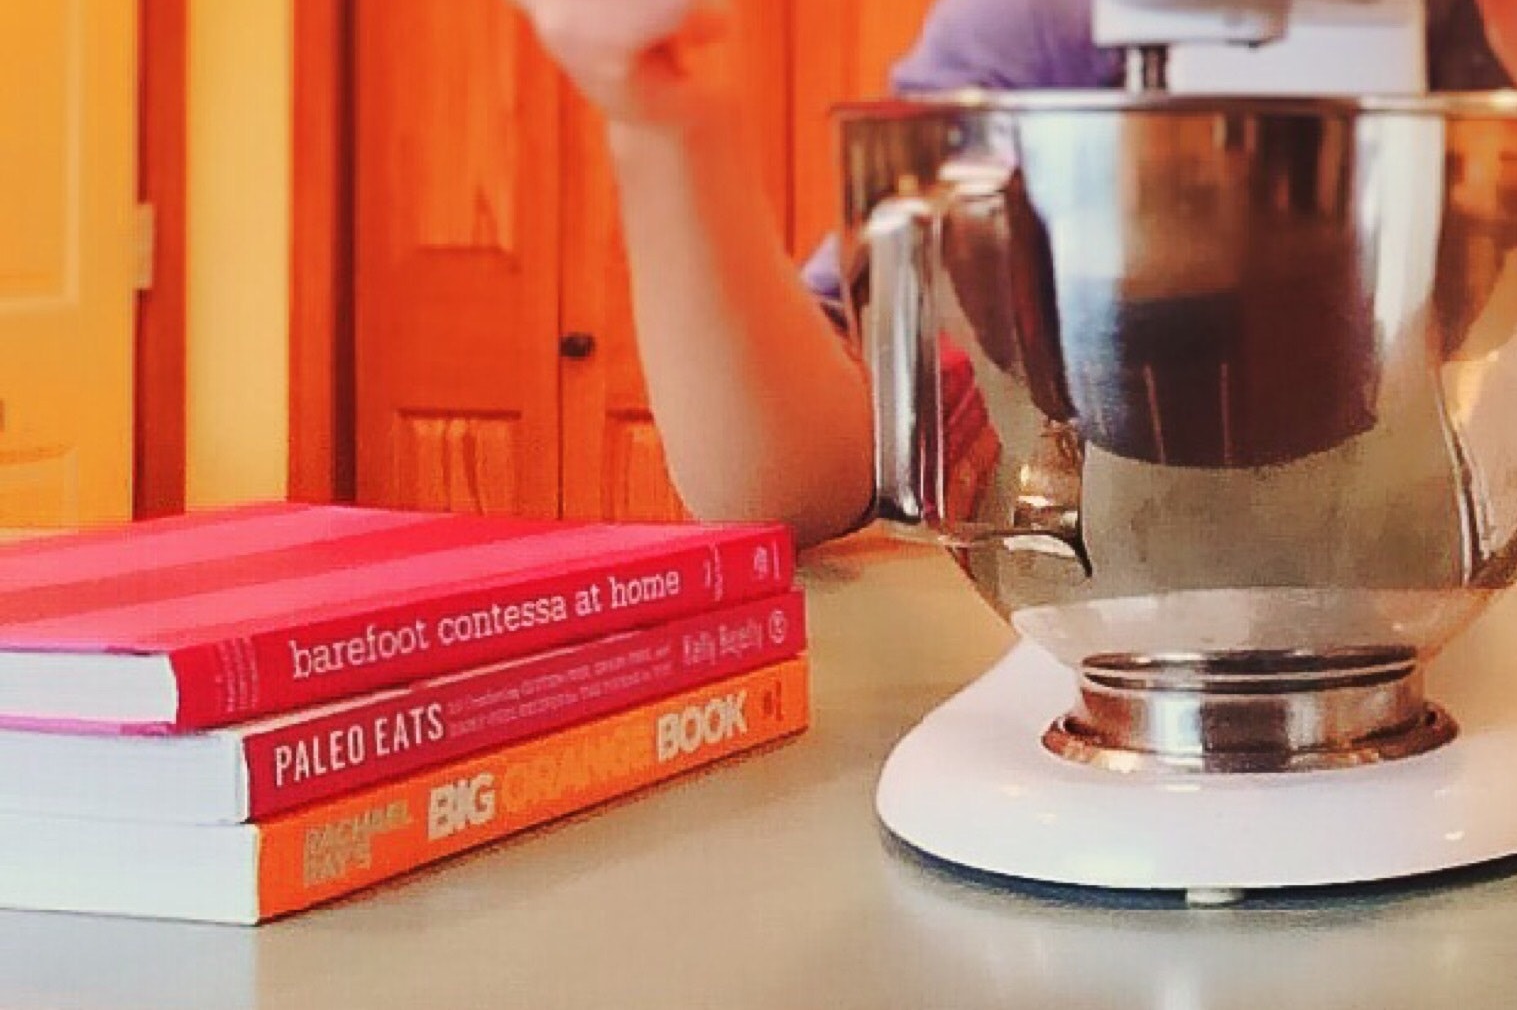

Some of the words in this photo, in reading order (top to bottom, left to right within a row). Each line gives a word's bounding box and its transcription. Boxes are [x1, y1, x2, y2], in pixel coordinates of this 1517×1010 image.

[289, 620, 430, 678] barefoot
[438, 595, 567, 645] contessa
[575, 583, 601, 617] at
[607, 570, 679, 609] home
[275, 724, 365, 787] PALEO
[374, 702, 444, 757] EATS
[427, 772, 496, 841] BIG
[657, 689, 748, 762] BOOK
